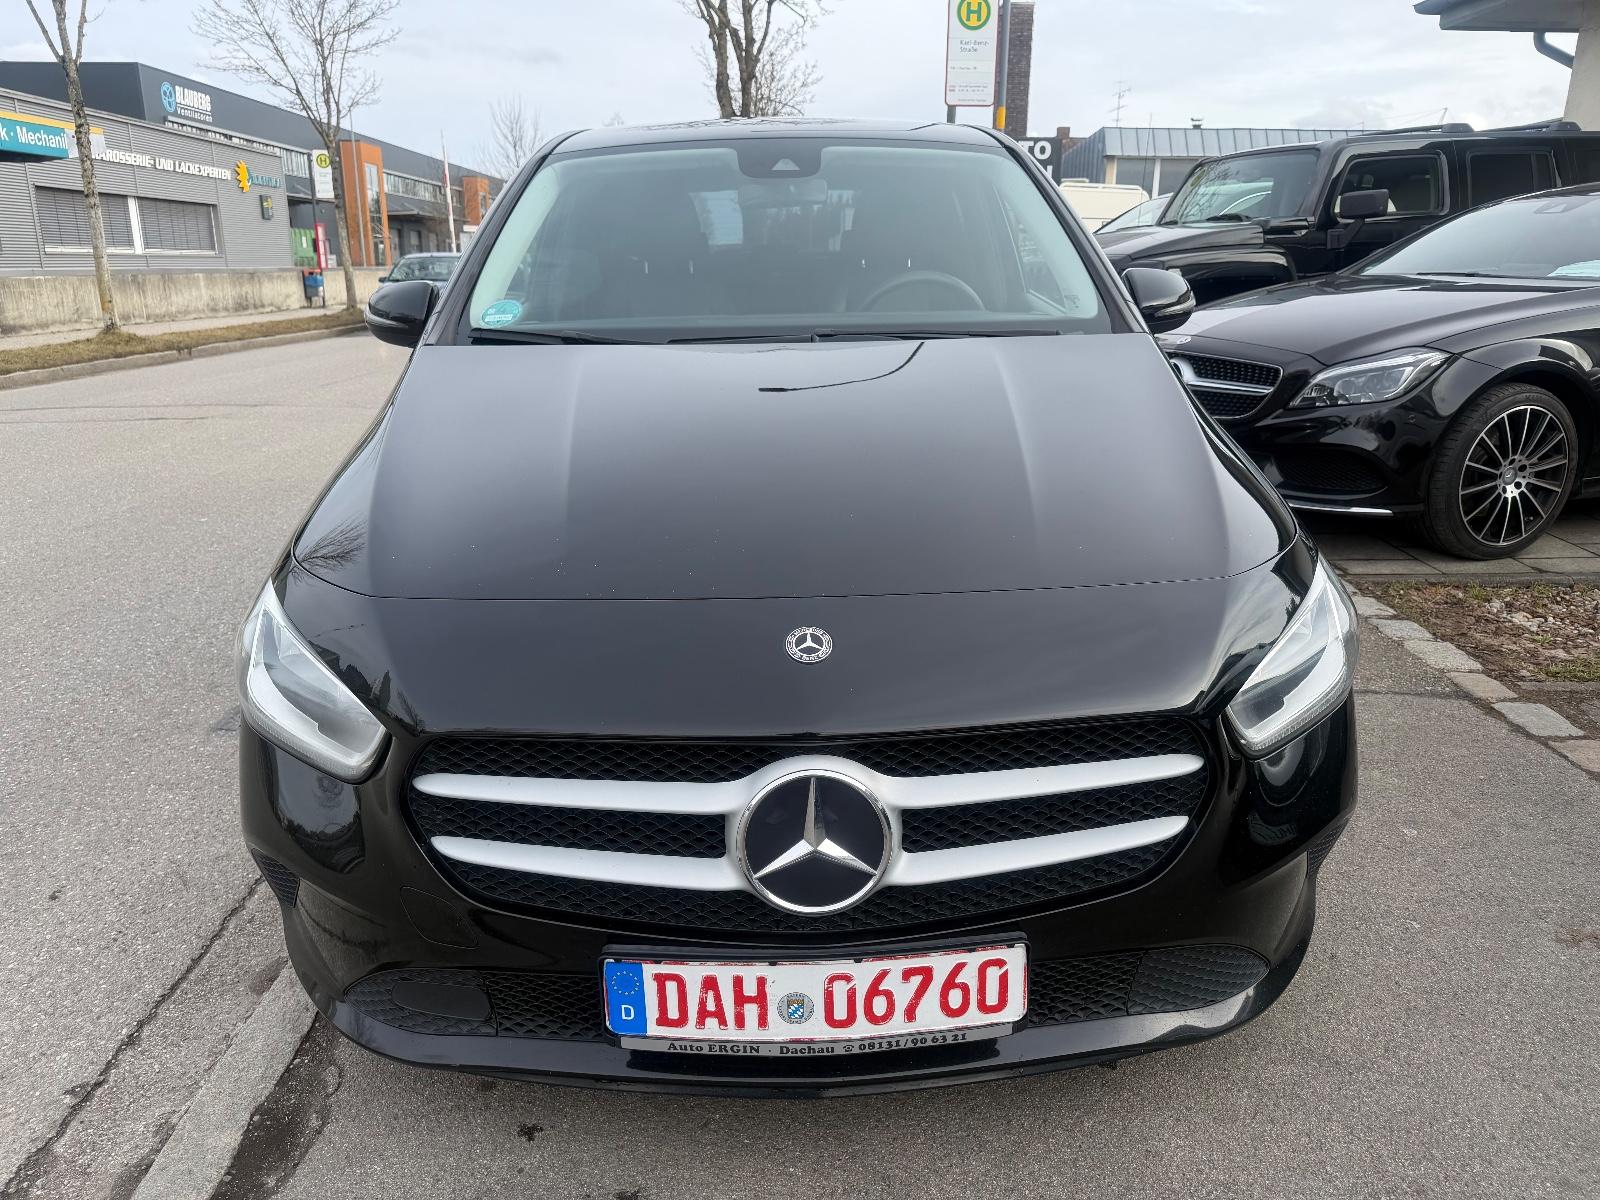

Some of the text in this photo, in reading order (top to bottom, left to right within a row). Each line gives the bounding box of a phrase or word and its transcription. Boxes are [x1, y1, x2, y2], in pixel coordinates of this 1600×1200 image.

[175, 85, 211, 112] BLAUBERG
[155, 157, 174, 171] UND
[175, 160, 232, 180] LACKEXPERTEN
[651, 972, 769, 1031] DAH
[823, 957, 1010, 1029] 06760
[621, 1004, 635, 1020] D
[667, 1042, 703, 1053] Auto
[707, 1043, 761, 1055] ERGIN
[779, 1045, 835, 1055] Dachau
[931, 1034, 948, 1045] 63
[951, 1032, 968, 1042] 21
